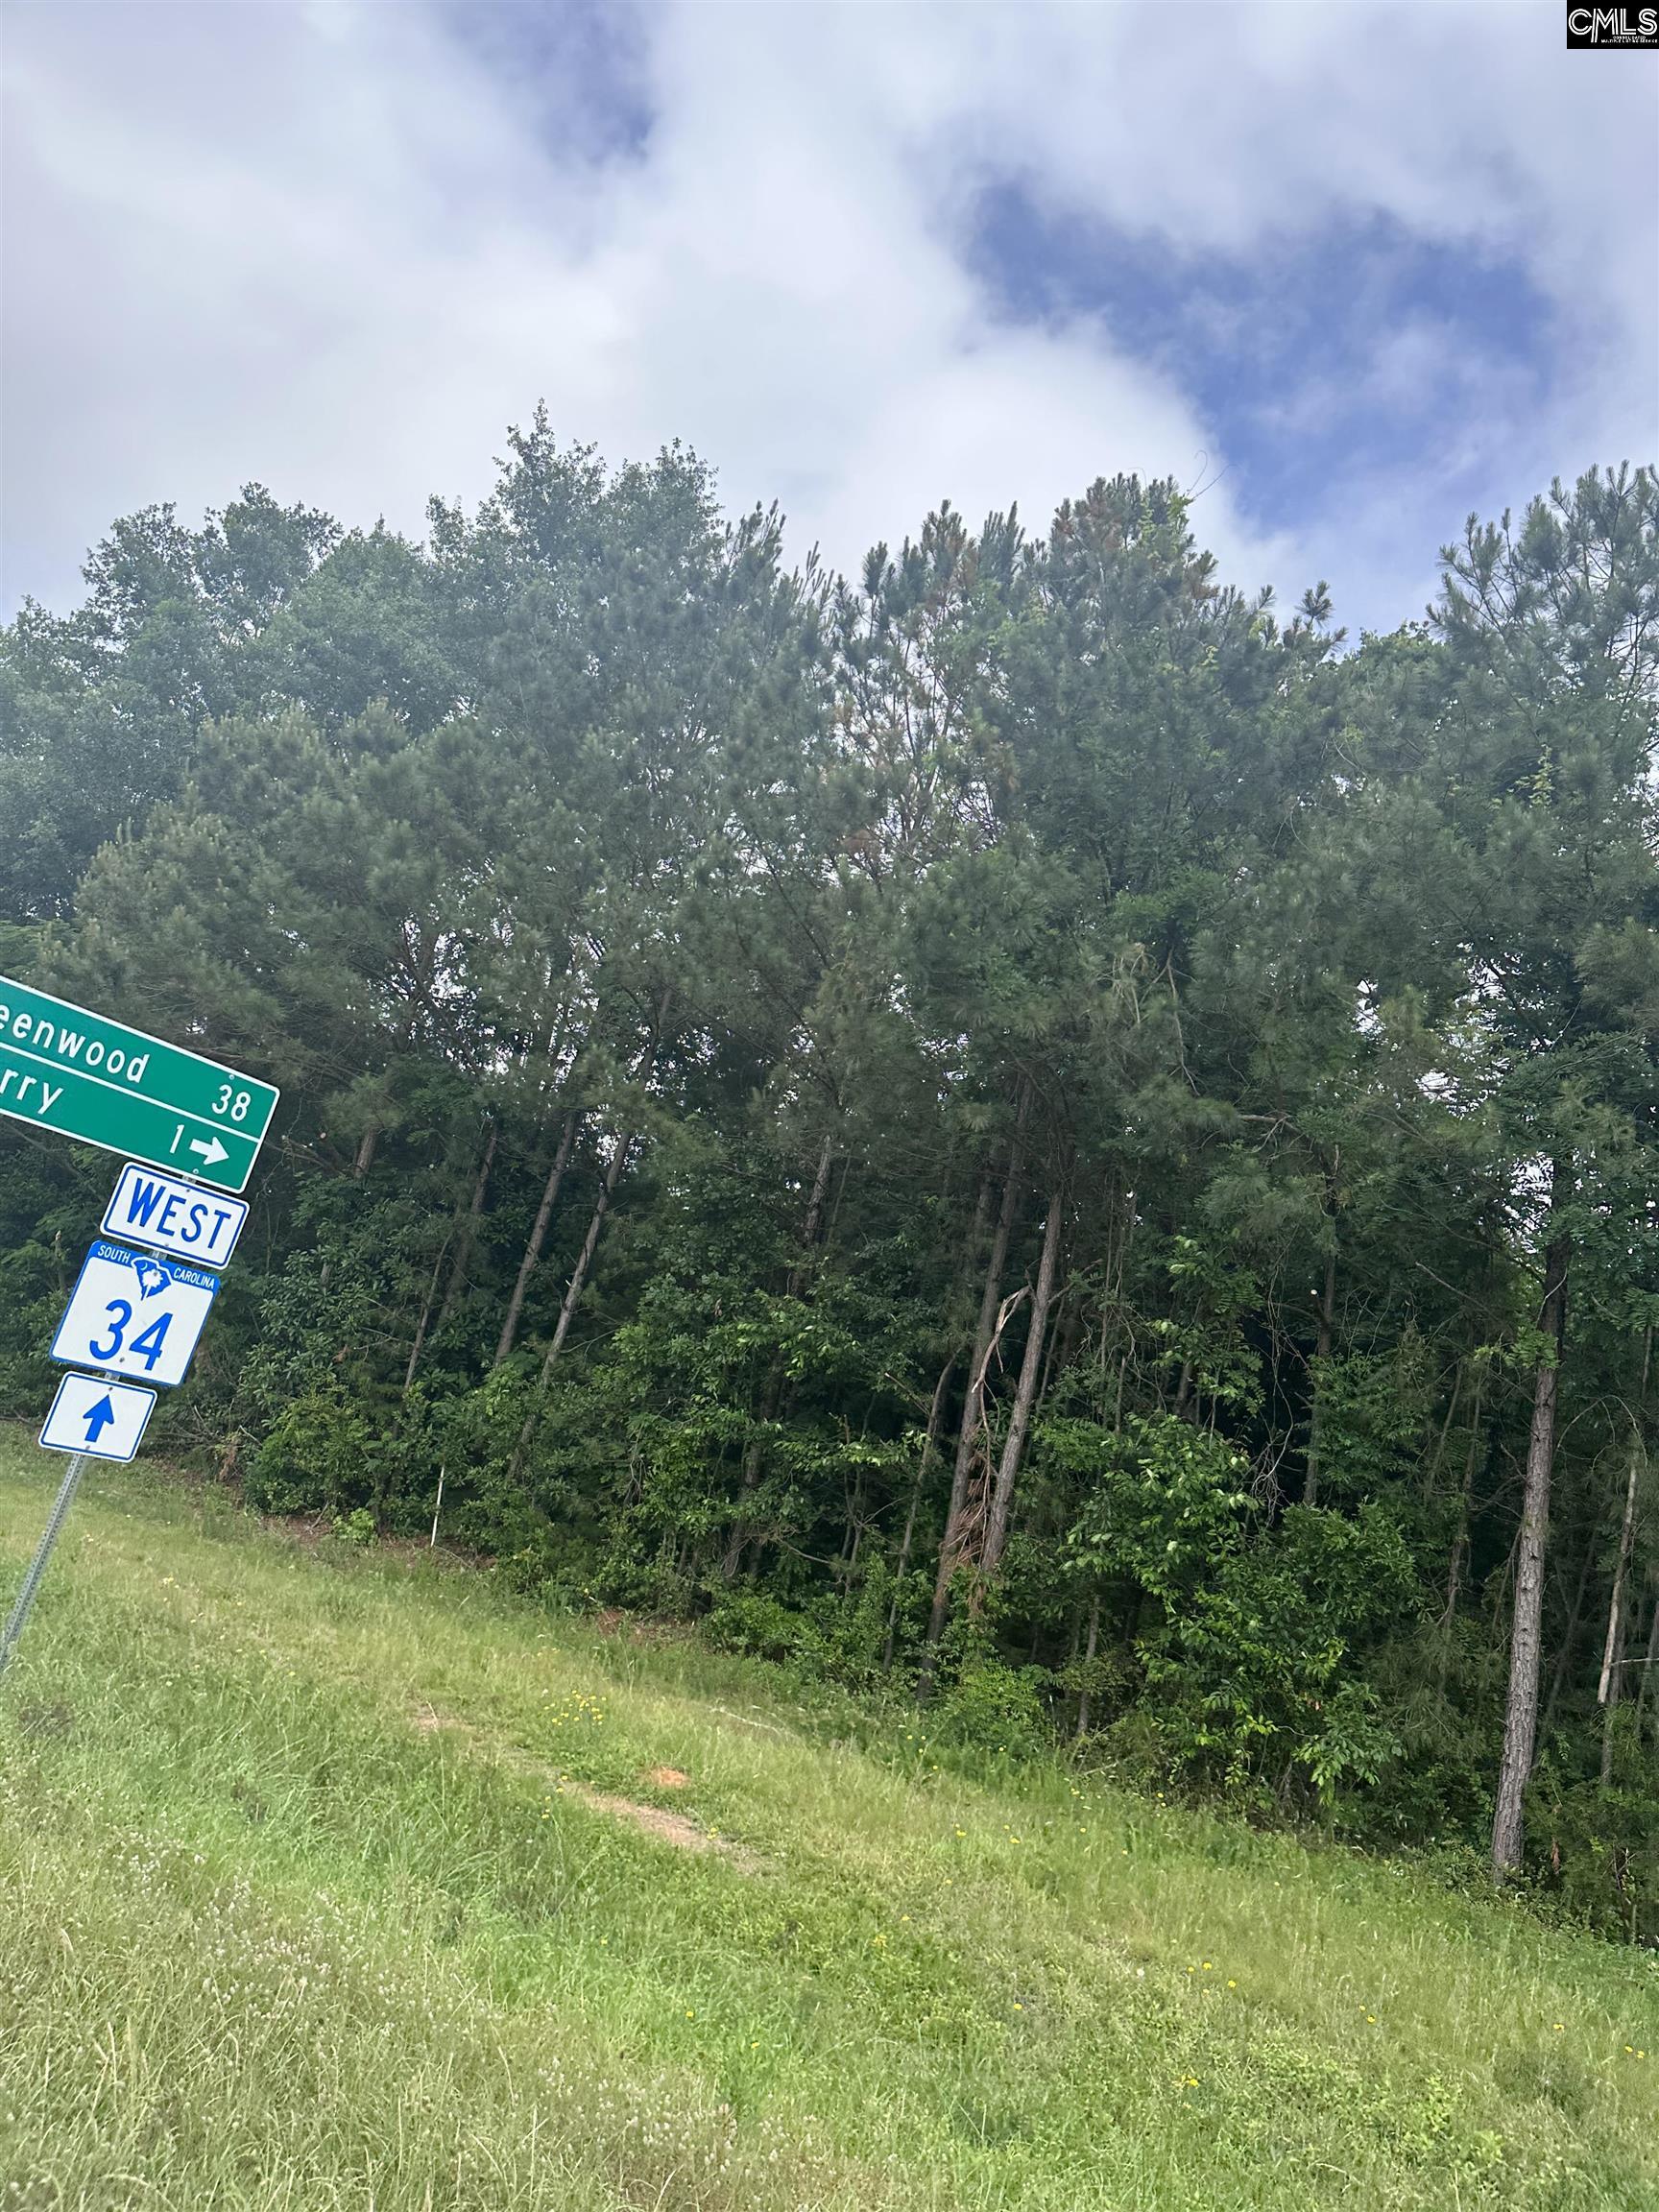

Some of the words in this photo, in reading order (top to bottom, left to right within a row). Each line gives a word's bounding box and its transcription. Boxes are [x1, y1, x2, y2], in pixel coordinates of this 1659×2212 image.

[0, 1069, 63, 1115] rry
[169, 1124, 184, 1154] 1
[211, 1084, 252, 1121] 38
[127, 1178, 231, 1249] WEST
[97, 1245, 131, 1263] SOUTH
[173, 1267, 215, 1289] CAROLINA
[89, 1299, 174, 1371] 34
